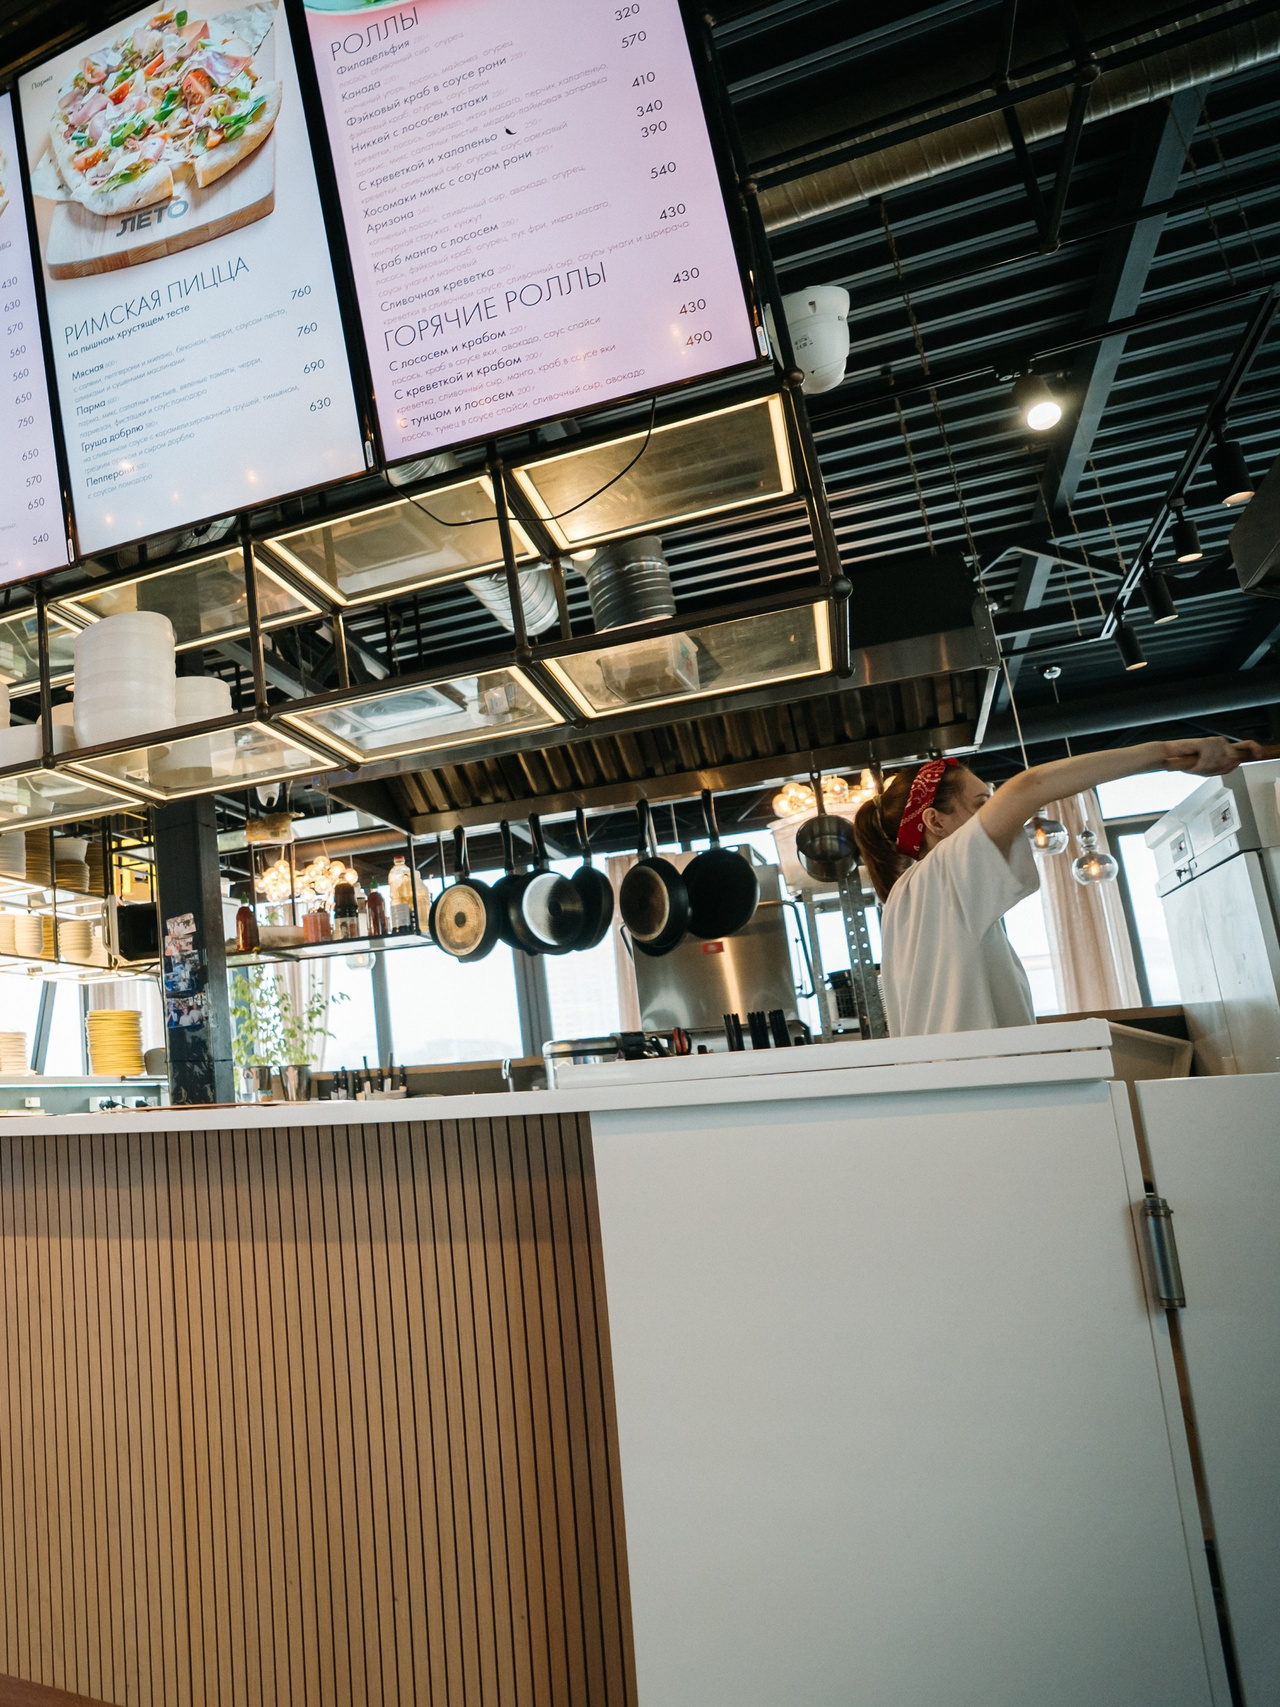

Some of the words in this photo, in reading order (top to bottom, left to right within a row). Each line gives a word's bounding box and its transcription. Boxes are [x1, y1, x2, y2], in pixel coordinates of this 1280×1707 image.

[614, 3, 640, 20] 320
[330, 6, 419, 61] РОЛЛЫ
[621, 30, 646, 48] 570
[336, 39, 409, 75] Филадельфия
[31, 75, 53, 90] Парма
[631, 71, 655, 87] 410
[341, 80, 381, 102] Канада
[345, 98, 401, 126] Фэйковый
[403, 85, 431, 105] краб
[432, 84, 440, 92] в
[441, 70, 474, 88] соусе
[477, 57, 506, 77] рони
[636, 99, 662, 117] 340
[350, 131, 390, 153] Никкей
[392, 129, 399, 137] с
[401, 110, 449, 134] лососем
[450, 93, 488, 113] татаки
[640, 120, 667, 137] 390
[357, 180, 367, 191] С
[369, 158, 425, 187] креветкой
[427, 157, 435, 165] и
[437, 133, 498, 162] халапеньо
[650, 161, 677, 179] 540
[362, 193, 417, 219] Хосомаки
[419, 182, 446, 197] микс
[448, 178, 455, 186] с
[457, 162, 500, 183] соусом
[502, 150, 532, 170] рони
[116, 200, 189, 237] ЛЕТО
[659, 202, 686, 220] 430
[366, 210, 414, 234] Аризона
[372, 253, 402, 273] Краб
[404, 244, 438, 262] манго
[440, 241, 447, 249] с
[449, 223, 499, 246] лососем
[1, 275, 18, 289] 430
[672, 266, 700, 283] 430
[290, 284, 312, 300] 760
[379, 286, 440, 312] Сливочная
[442, 268, 494, 292] креветка
[3, 298, 21, 312] 630
[64, 288, 161, 345] РИМСКАЯ
[166, 256, 249, 303] ПИЦЦА
[383, 295, 498, 352] ГОРЯЧИЕ
[504, 261, 606, 313] РОЛЛЫ
[678, 298, 706, 314] 430
[6, 321, 24, 335] 570
[67, 349, 79, 358] на
[79, 334, 115, 353] пышном
[116, 314, 165, 339] хрустящем
[166, 304, 190, 318] тесте
[296, 321, 318, 337] 760
[685, 329, 713, 346] 490
[9, 344, 26, 358] 560
[388, 360, 398, 371] С
[400, 348, 449, 369] лососем
[450, 344, 459, 352] и
[461, 330, 506, 351] крабом
[509, 324, 523, 334] 220
[12, 367, 29, 382] 560
[71, 363, 104, 380] Мясная
[303, 358, 325, 374] 690
[393, 388, 403, 400] С
[405, 371, 463, 398] креветкой
[465, 370, 474, 378] и
[476, 356, 522, 377] крабом
[524, 351, 539, 361] 200
[14, 391, 32, 405] 650
[309, 396, 331, 412] 630
[410, 408, 452, 427] тунцом
[453, 404, 461, 413] и
[464, 390, 514, 411] лососем
[516, 385, 531, 395] 200
[75, 399, 106, 416] Парма
[17, 414, 34, 428] 750
[80, 437, 108, 453] Груша
[108, 424, 144, 443] добрлю
[21, 447, 39, 461] 650
[25, 473, 42, 487] 570
[27, 496, 45, 510] 650
[32, 532, 49, 545] 540
